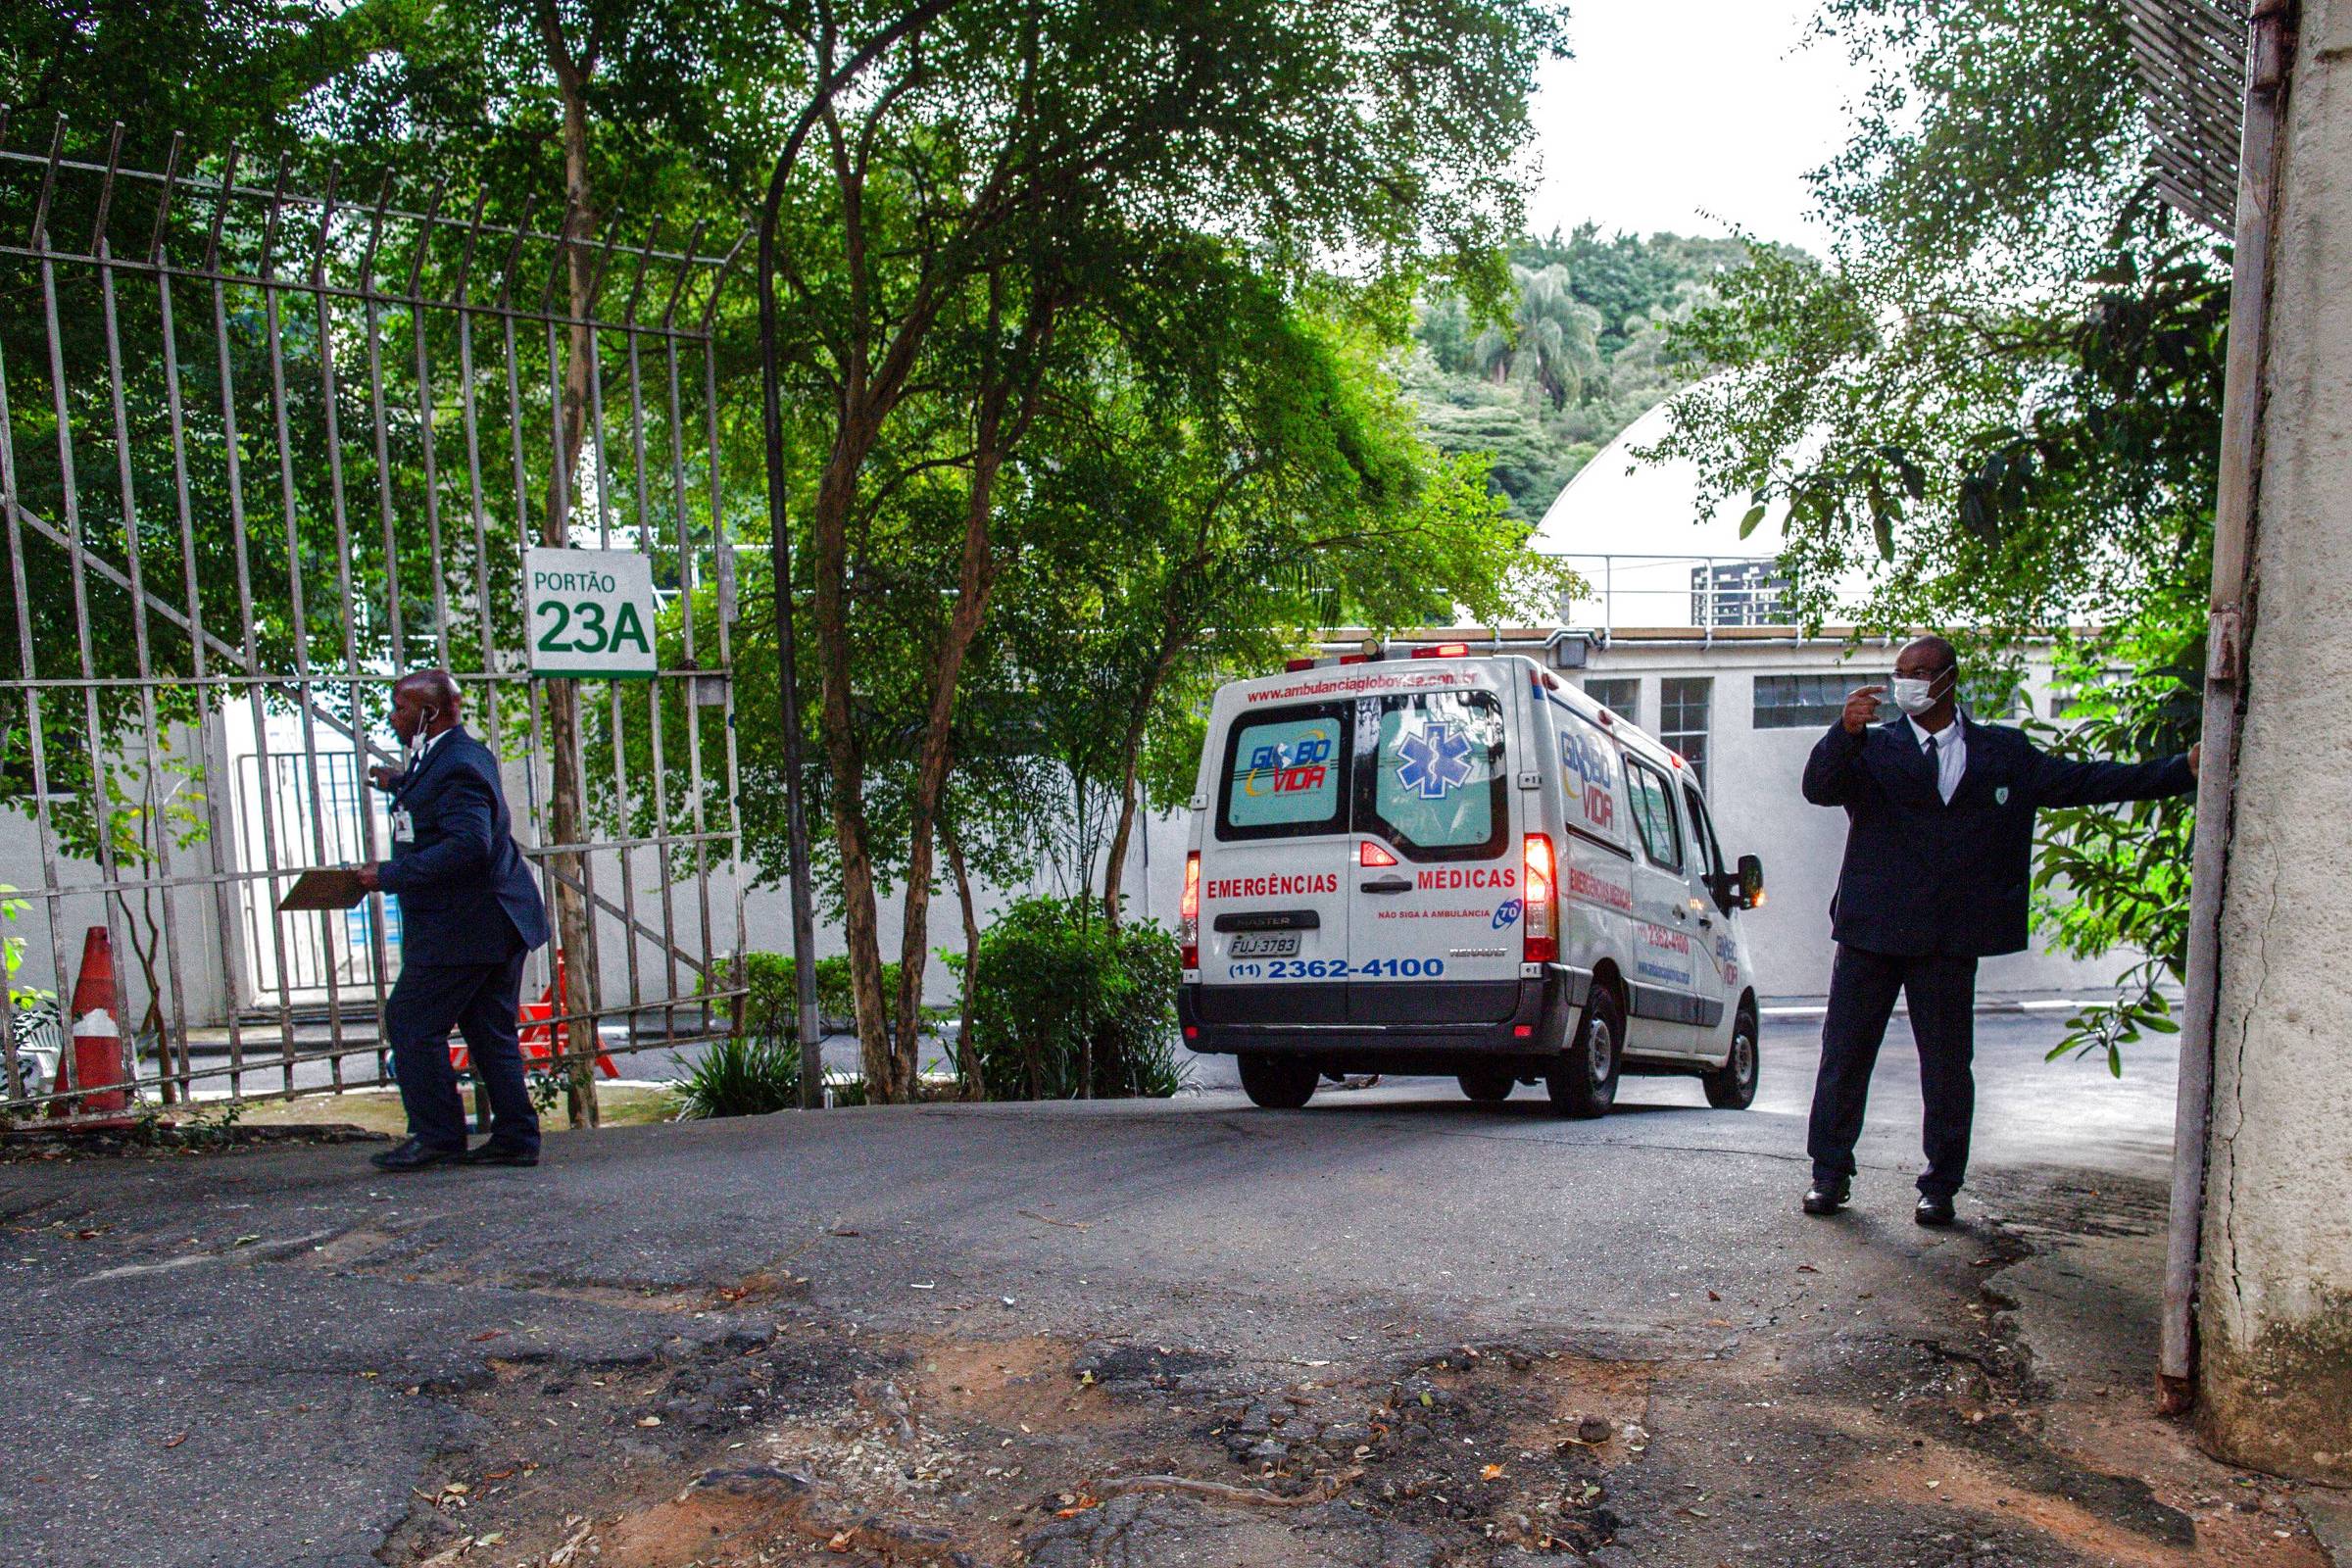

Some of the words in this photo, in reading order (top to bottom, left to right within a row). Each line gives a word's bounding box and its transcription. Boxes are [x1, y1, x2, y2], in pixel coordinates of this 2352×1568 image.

[535, 571, 615, 593] PORTÃO
[536, 600, 651, 654] 23A
[1273, 765, 1327, 793] VIDA
[1206, 873, 1338, 900] EMERGÊNCIAS
[1417, 866, 1516, 890] MÉDICAS
[1378, 909, 1396, 919] NÃO
[1399, 909, 1420, 919] SIGA
[1431, 908, 1491, 919] AMBULÂNCIA
[1499, 906, 1517, 918] 70
[1449, 948, 1508, 957] RENAULT
[1229, 963, 1261, 978] (11)
[1267, 958, 1445, 978] 2362-4100
